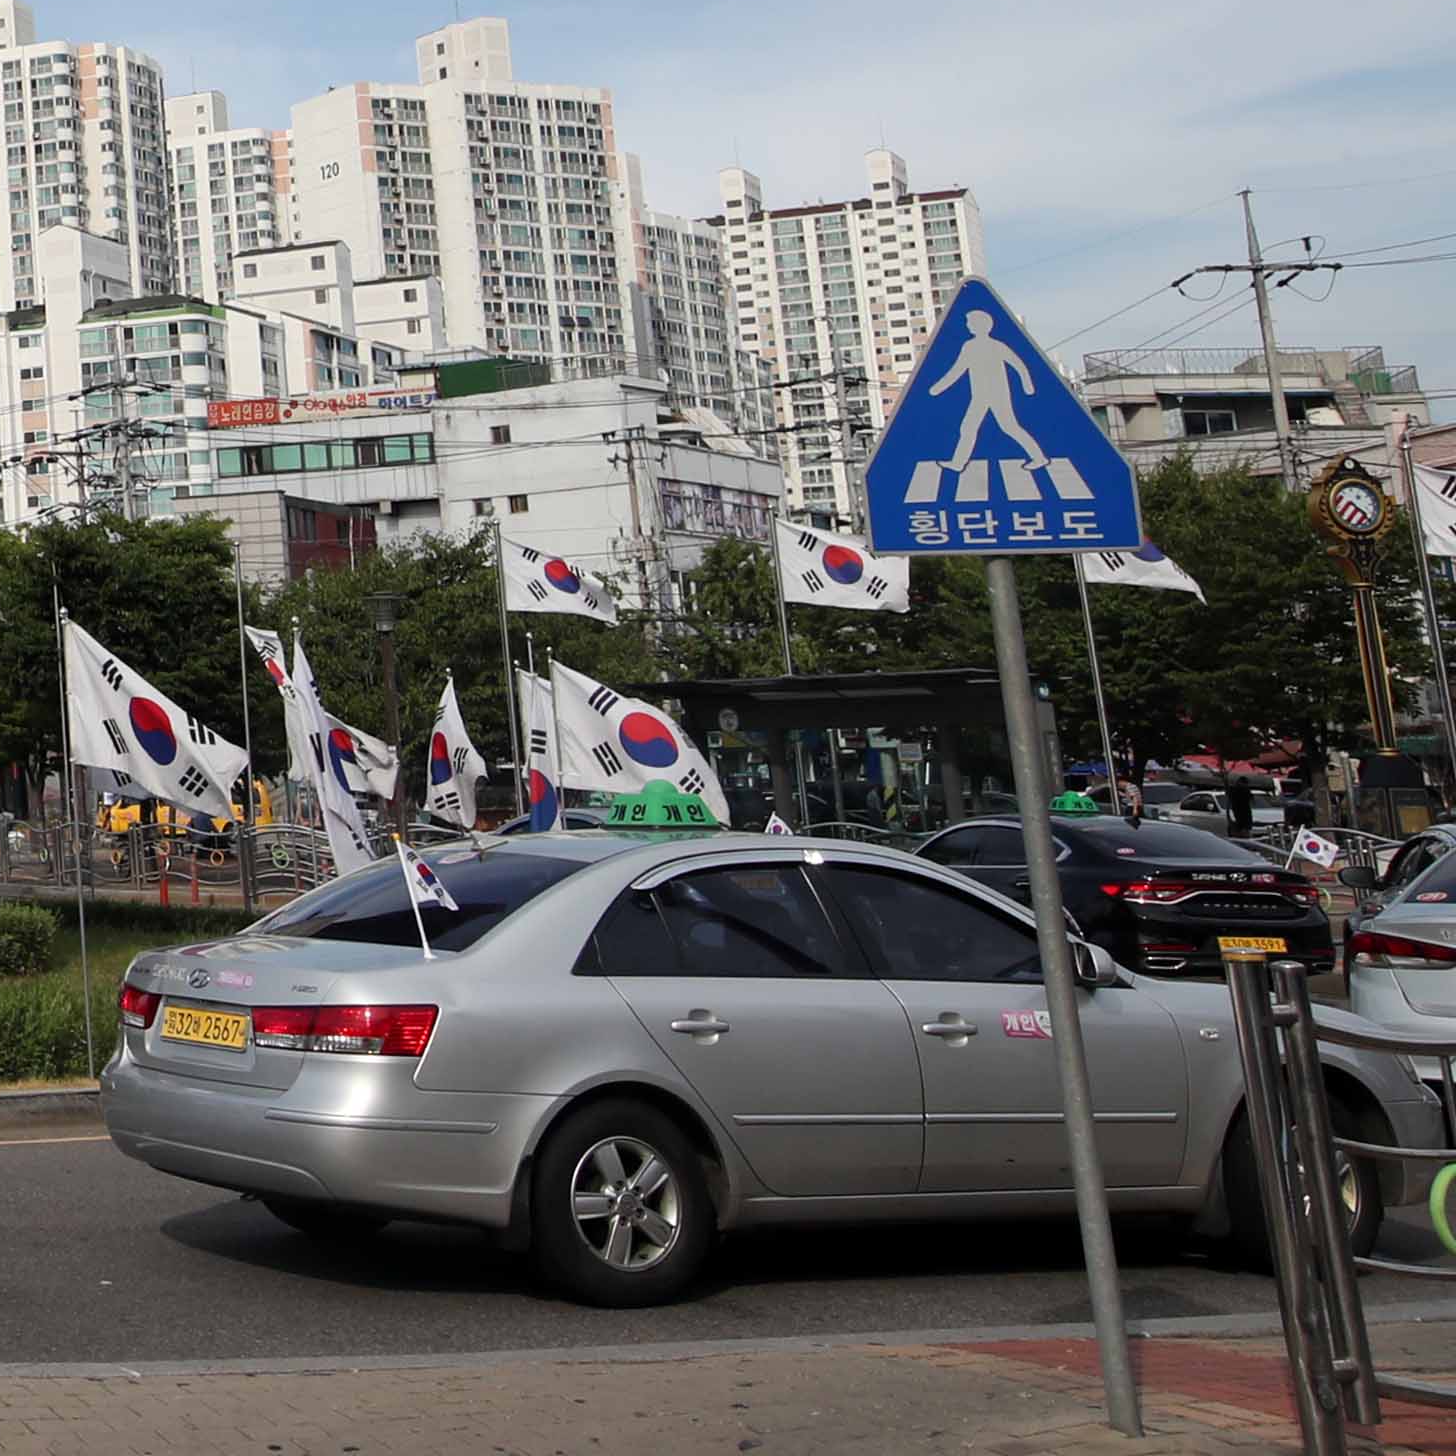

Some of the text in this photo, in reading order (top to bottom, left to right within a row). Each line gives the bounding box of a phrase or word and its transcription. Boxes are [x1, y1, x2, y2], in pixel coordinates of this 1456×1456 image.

[320, 162, 340, 181] 120
[908, 510, 1105, 544] 횡단보도
[611, 804, 707, 823] 개인 개인
[203, 1015, 241, 1043] 2567
